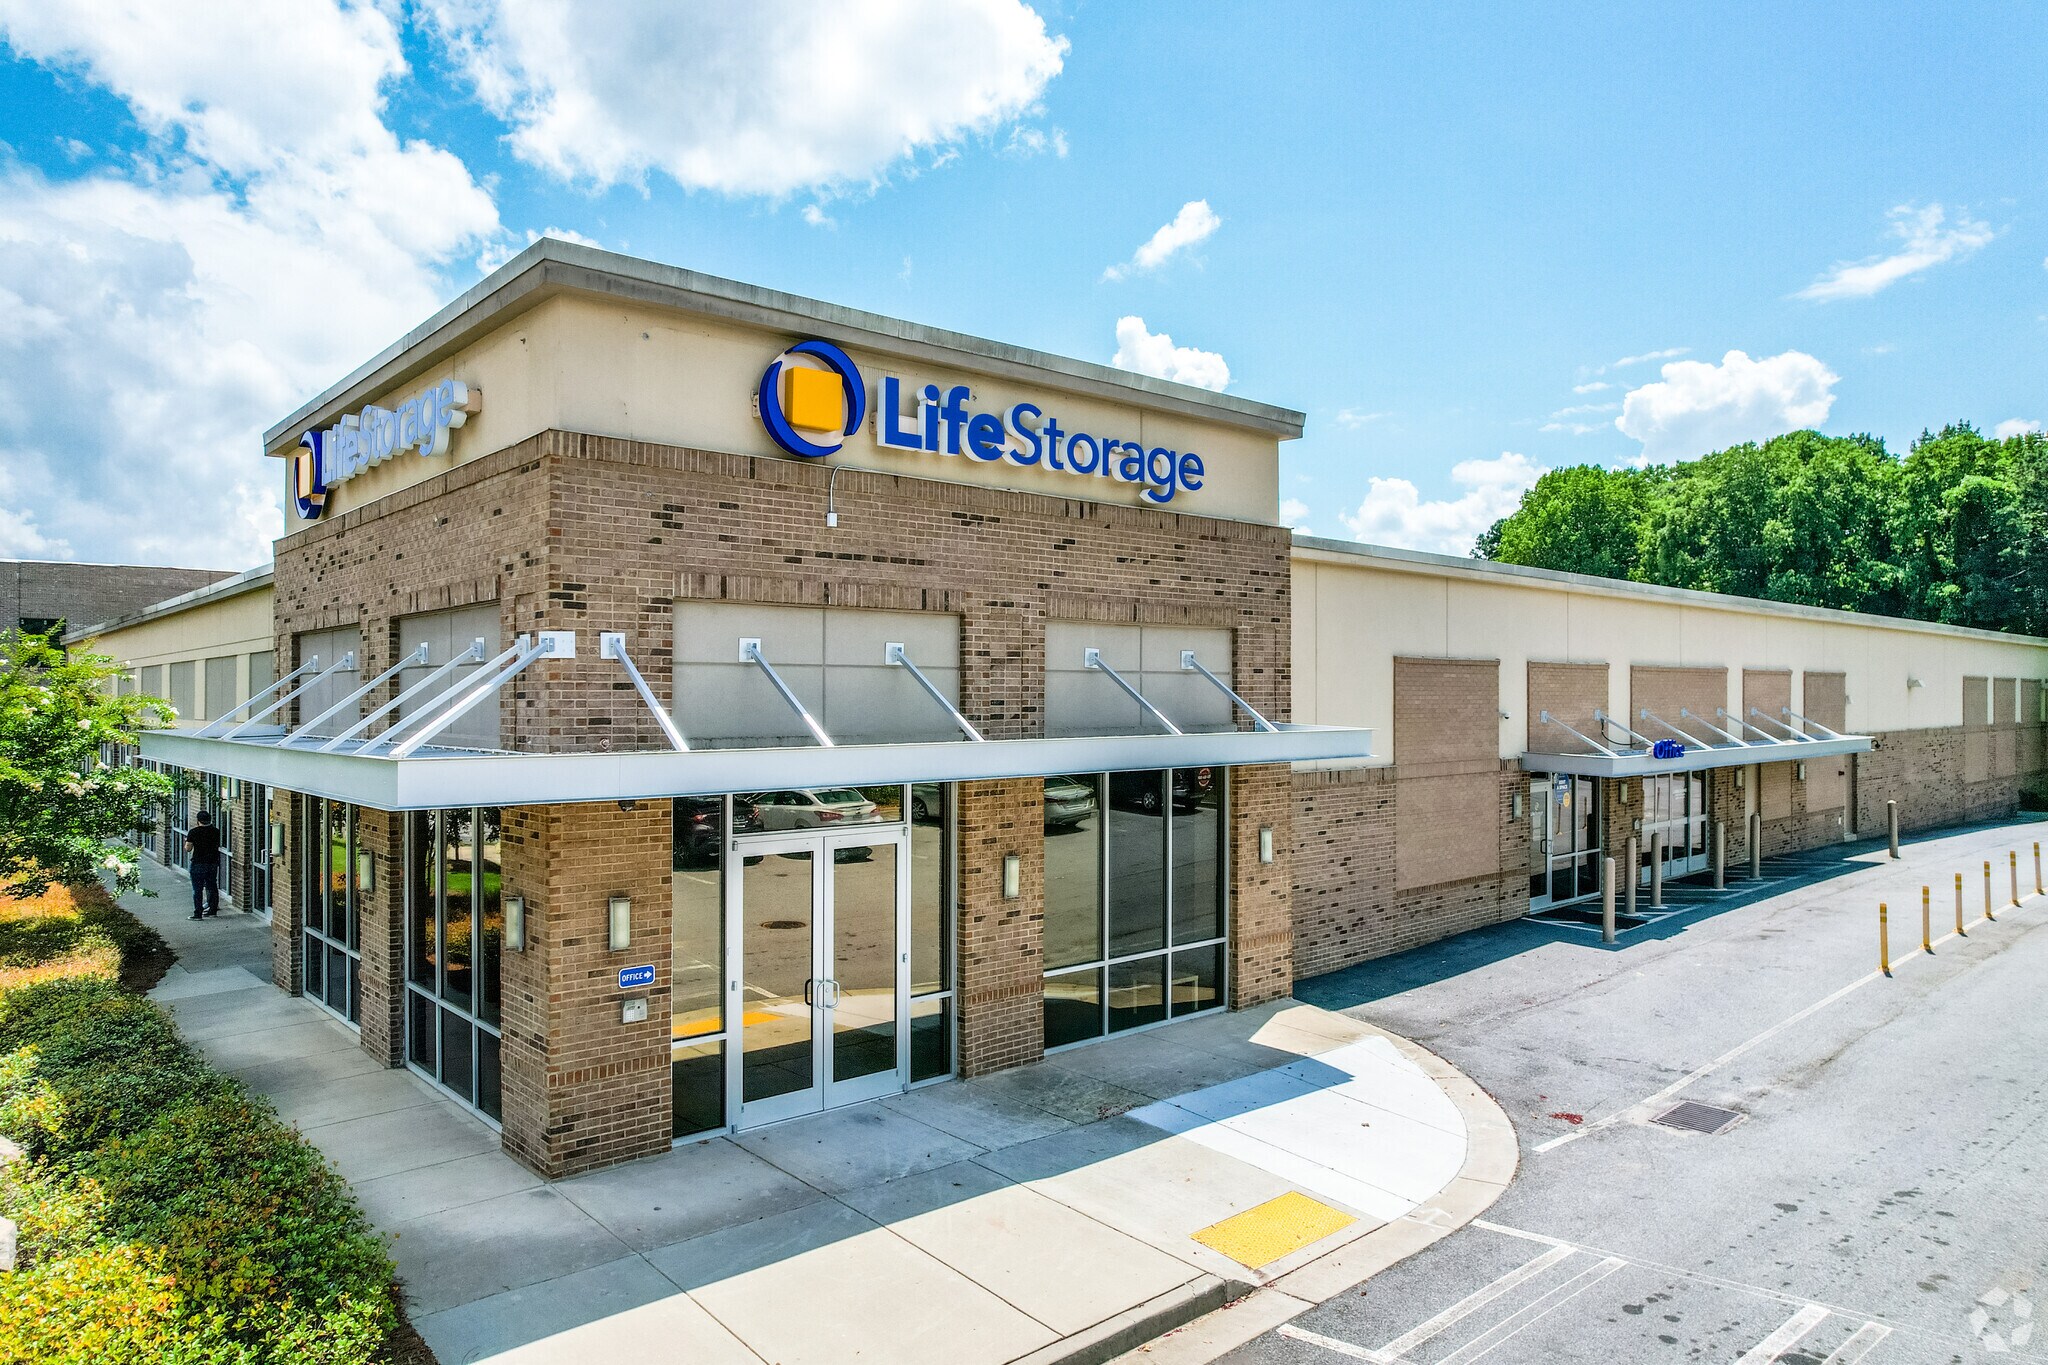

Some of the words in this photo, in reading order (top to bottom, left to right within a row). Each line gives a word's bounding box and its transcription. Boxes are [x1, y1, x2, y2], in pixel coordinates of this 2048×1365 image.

[321, 379, 459, 487] LifeStorage
[878, 376, 1206, 503] LifeStorage
[1653, 738, 1685, 759] Office
[621, 972, 643, 982] OFFICE
